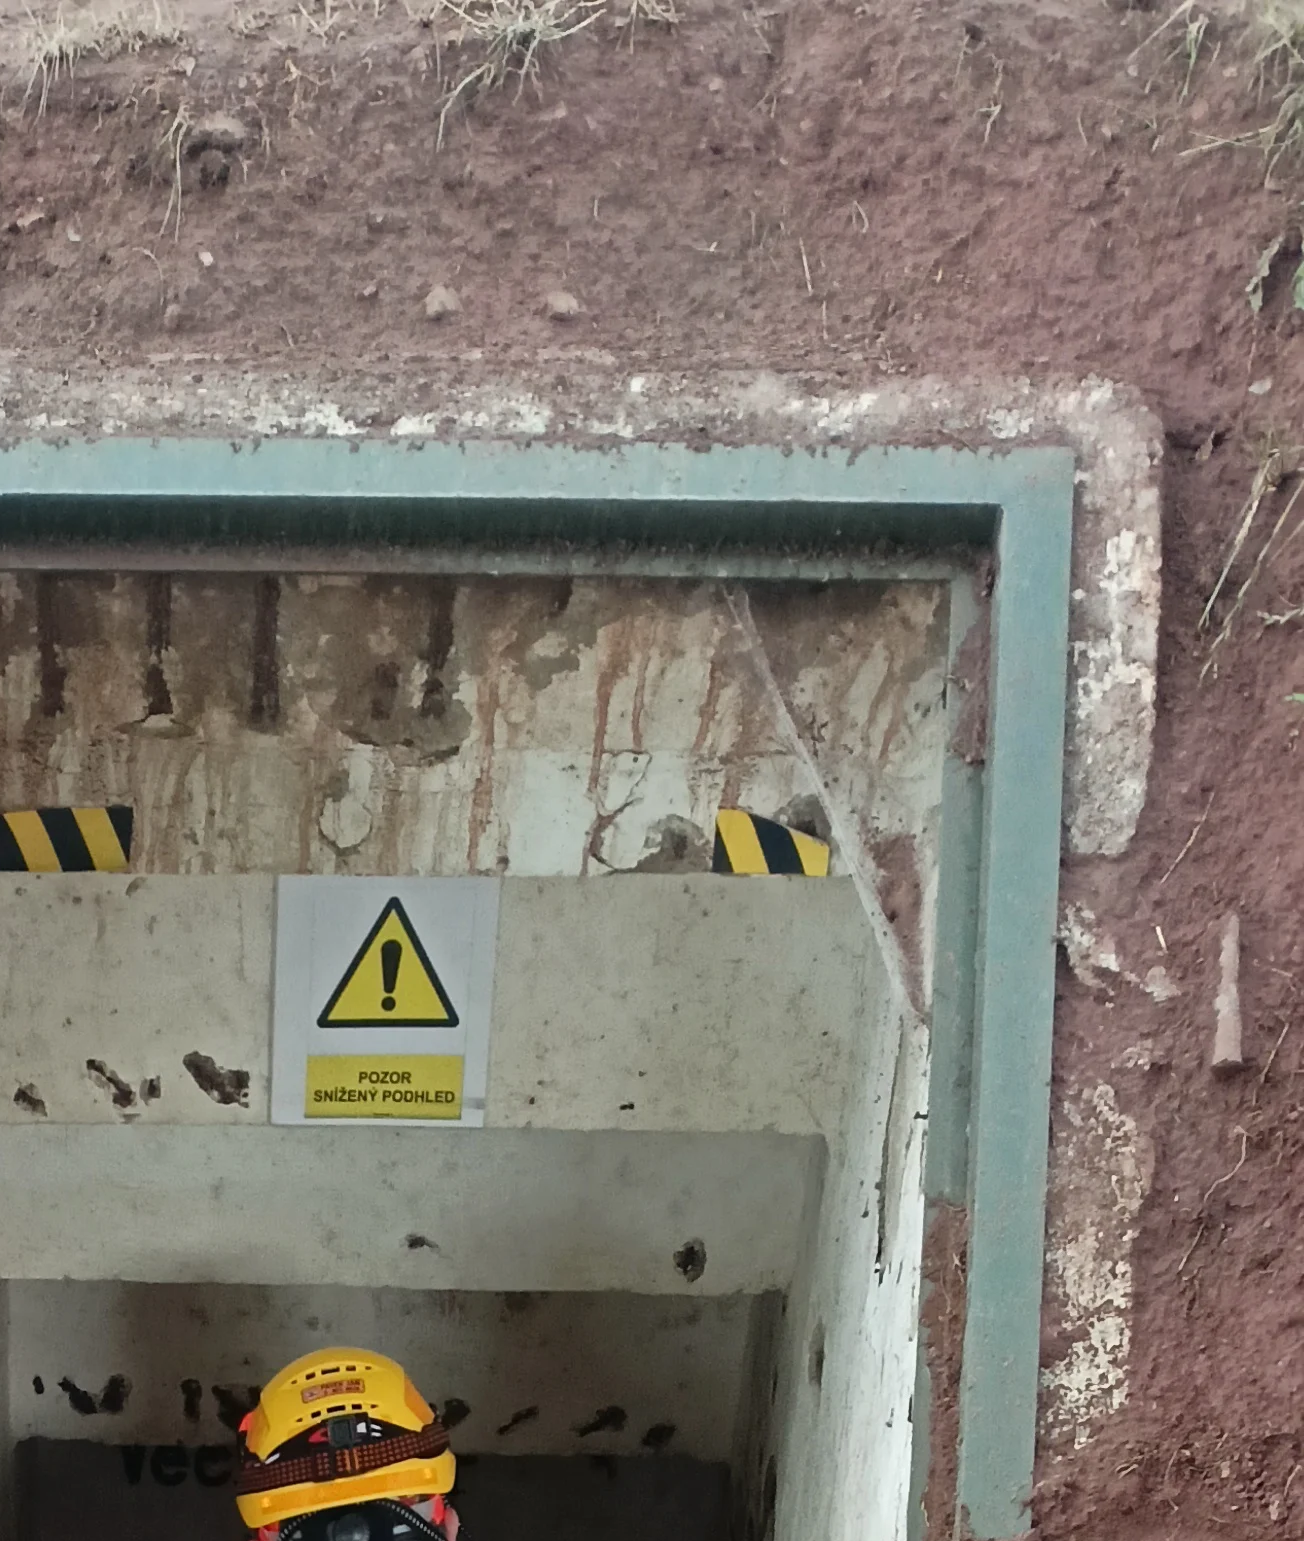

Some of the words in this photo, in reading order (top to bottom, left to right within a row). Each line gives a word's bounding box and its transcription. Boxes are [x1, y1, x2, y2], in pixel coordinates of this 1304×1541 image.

[358, 1071, 412, 1084] POZOR
[313, 1086, 378, 1103] SNÍŽENÝ
[382, 1089, 456, 1104] PODHLED
